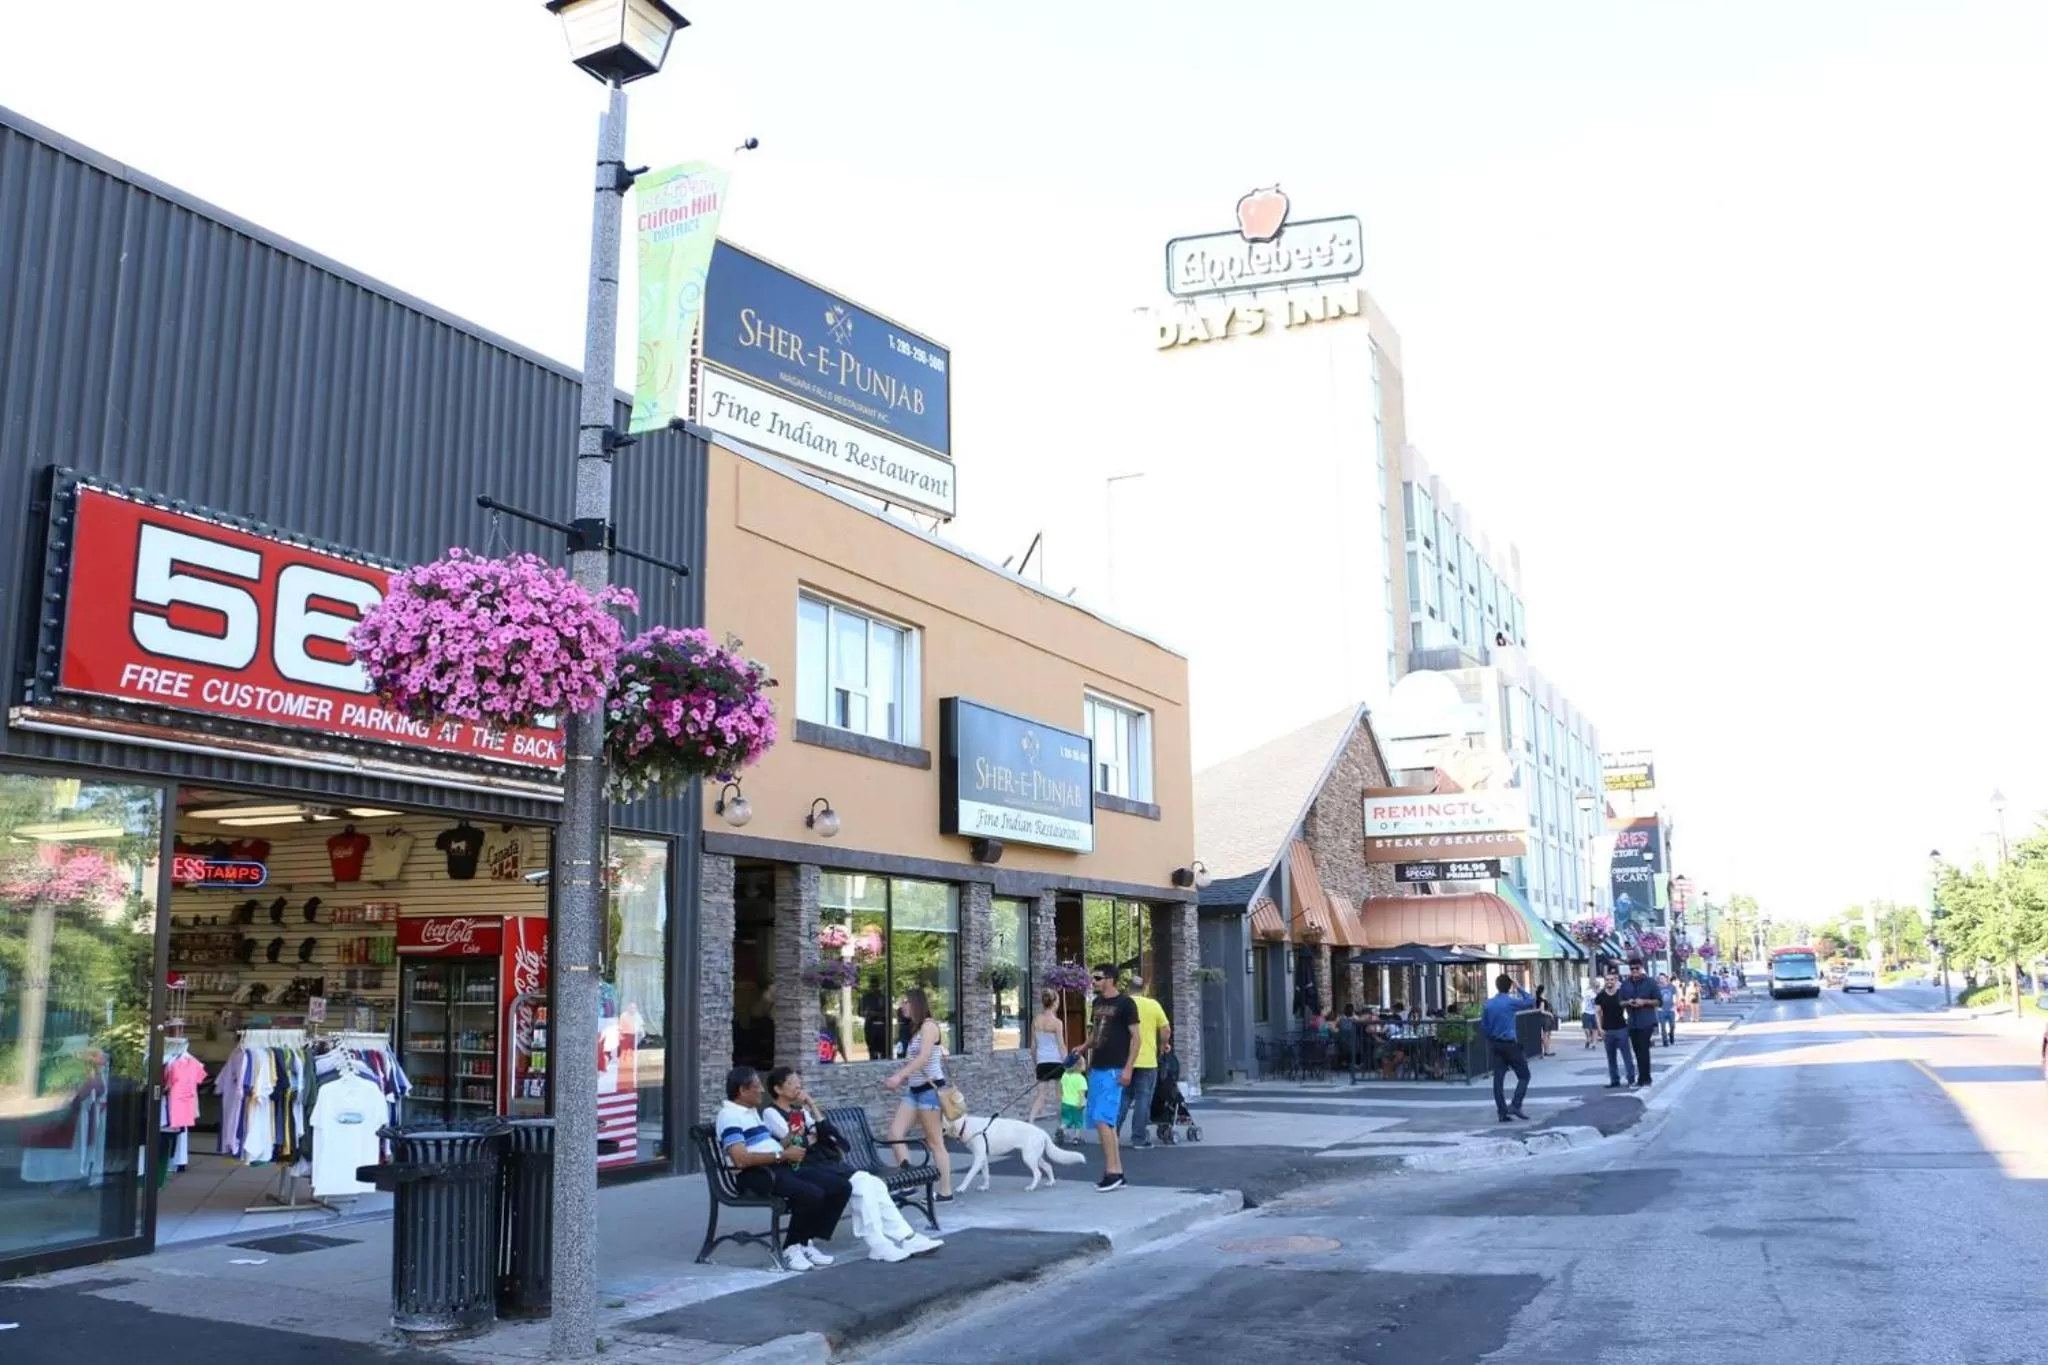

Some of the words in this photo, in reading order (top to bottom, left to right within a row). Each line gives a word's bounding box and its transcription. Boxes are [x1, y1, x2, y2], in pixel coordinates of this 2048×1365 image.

[638, 206, 688, 232] Clifton
[691, 192, 717, 216] Hill
[653, 218, 700, 242] DISTRICT
[1157, 307, 1265, 351] DAYS
[1285, 289, 1361, 328] INN
[707, 391, 761, 428] Fine
[766, 411, 839, 457] Indian
[845, 441, 949, 498] Restaurant
[119, 663, 194, 698] FREE
[202, 679, 333, 721] CUSTOMER
[340, 703, 429, 739] PARKING
[512, 734, 558, 761] BACK
[976, 809, 999, 829] Fine
[1001, 812, 1032, 834] Indian
[1035, 818, 1080, 841] Restaurant
[1375, 837, 1423, 849] STEAK
[1429, 836, 1441, 847] &
[1444, 833, 1517, 846] SEAFOOD
